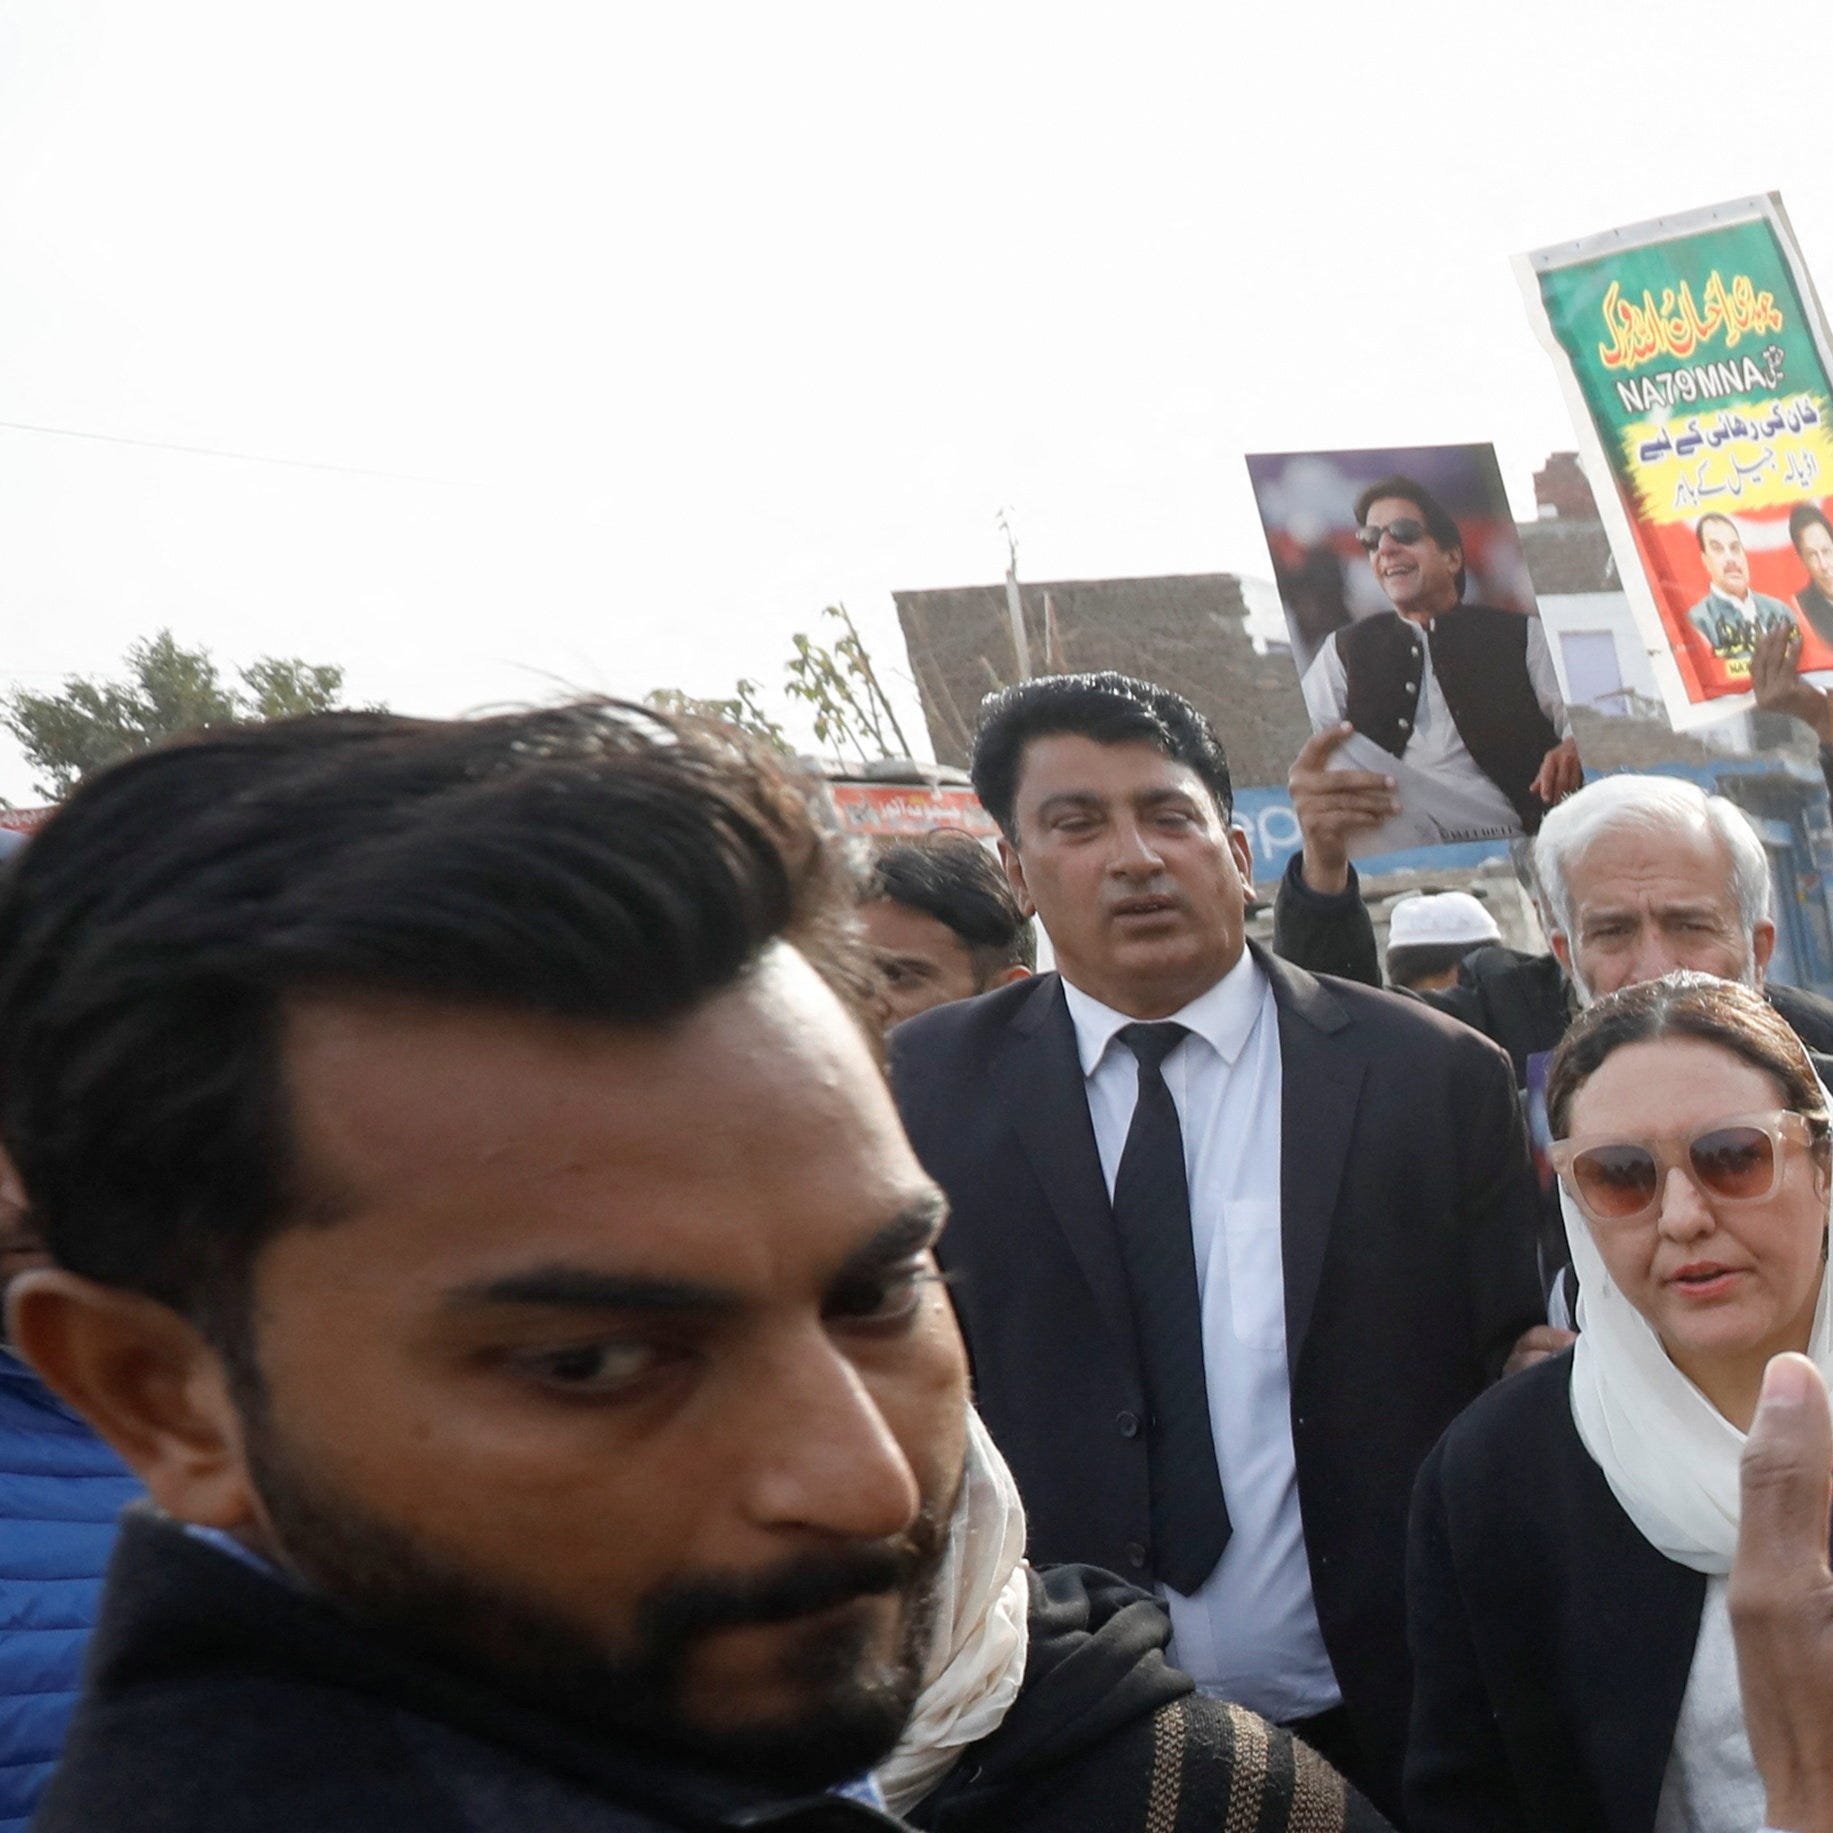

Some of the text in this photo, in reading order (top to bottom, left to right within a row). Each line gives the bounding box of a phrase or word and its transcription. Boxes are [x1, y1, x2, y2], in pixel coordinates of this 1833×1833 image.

[1759, 404, 1786, 438] کی
[1785, 392, 1818, 434] خان
[1675, 419, 1703, 456] کے
[1726, 447, 1777, 495] جیل
